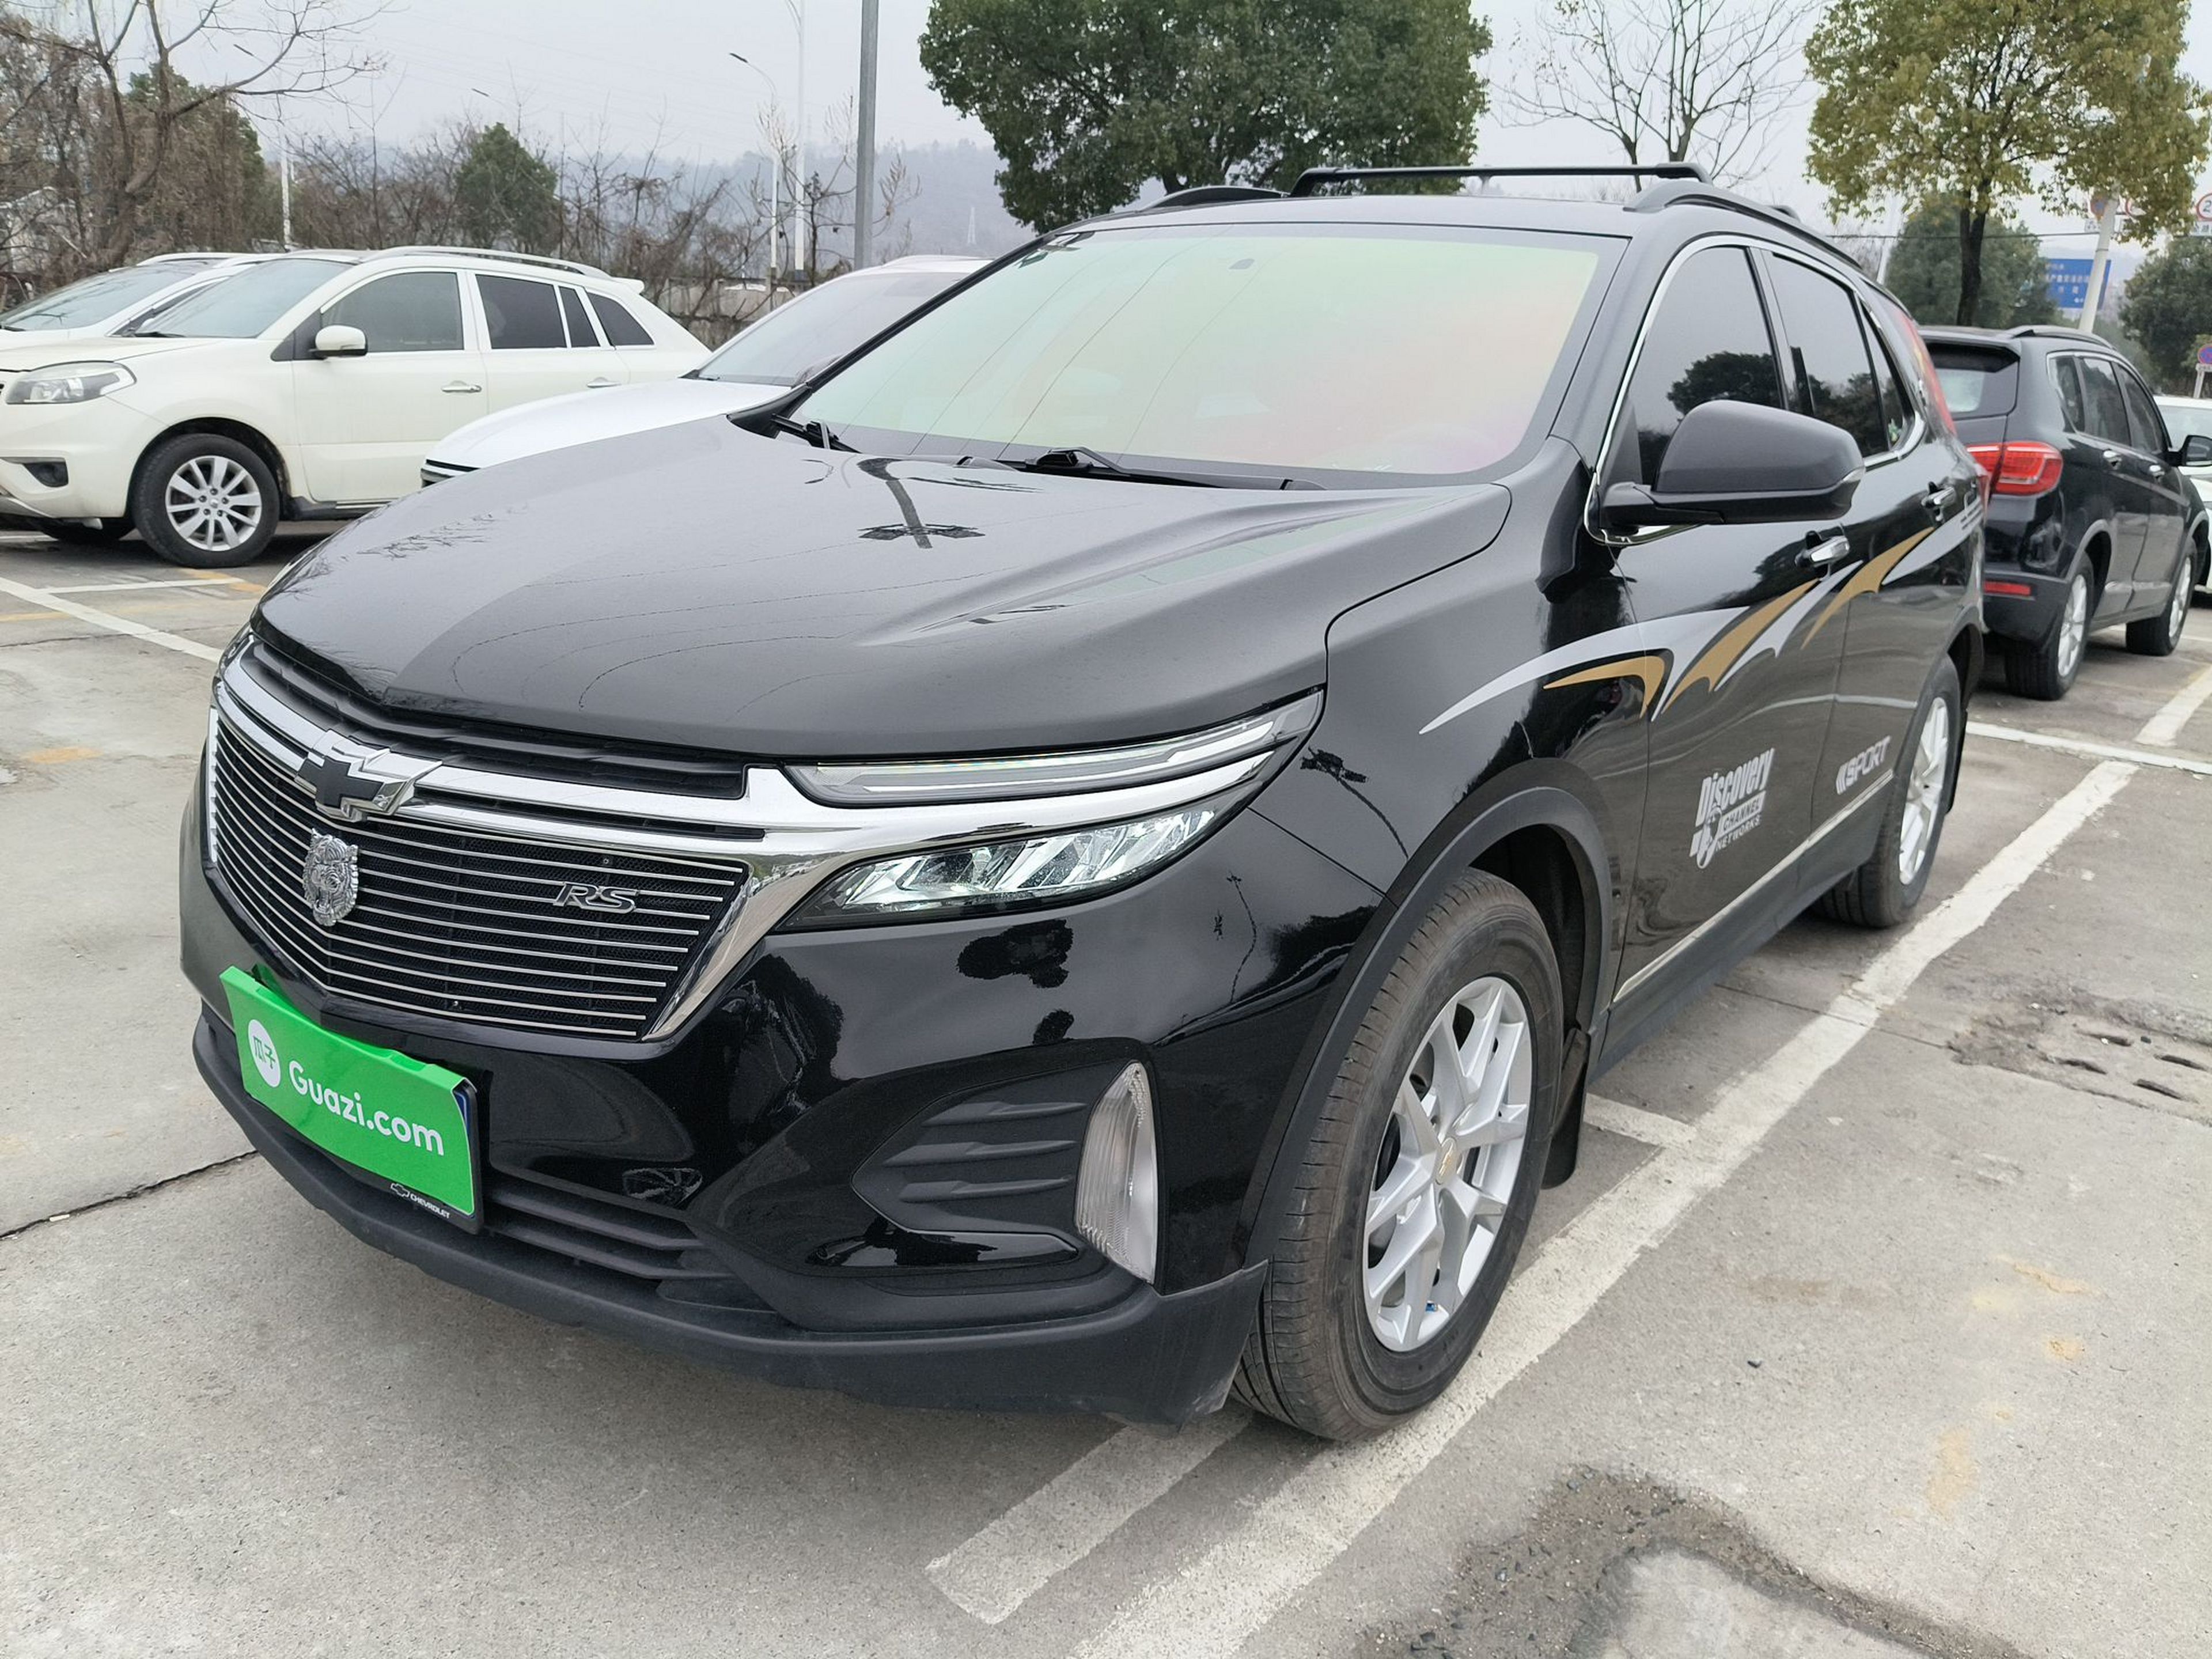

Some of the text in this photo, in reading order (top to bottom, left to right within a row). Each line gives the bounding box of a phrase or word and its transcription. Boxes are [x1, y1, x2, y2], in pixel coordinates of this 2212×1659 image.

[1722, 797, 1760, 831] CHANNEL
[1715, 814, 1761, 851] NETWORKS
[553, 881, 636, 914] RS
[253, 1036, 275, 1069] 瓜子
[289, 1060, 445, 1156] Guazi.com
[410, 1194, 450, 1218] CHEVROLET
